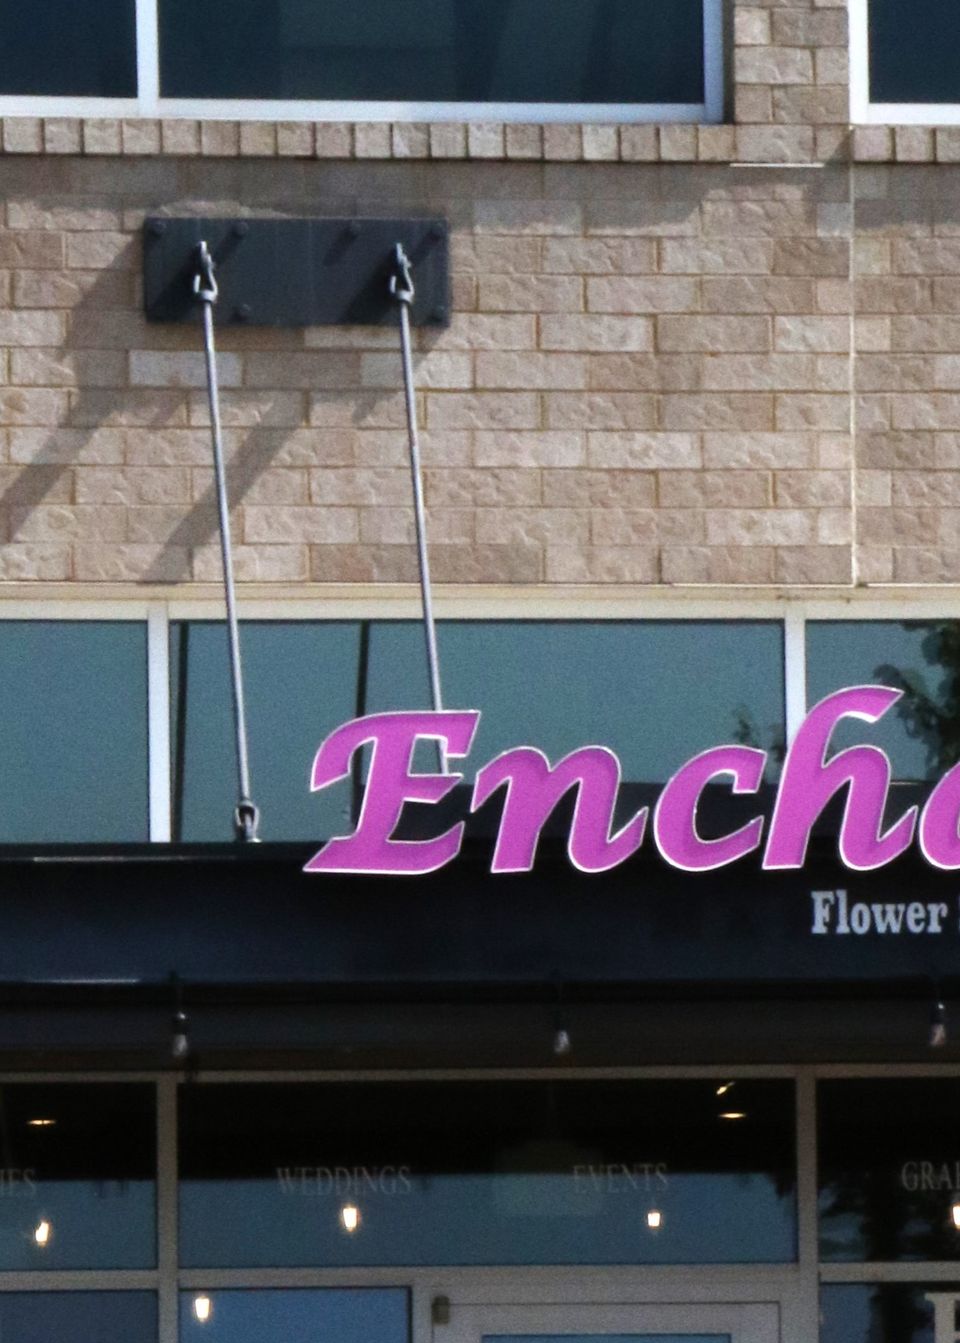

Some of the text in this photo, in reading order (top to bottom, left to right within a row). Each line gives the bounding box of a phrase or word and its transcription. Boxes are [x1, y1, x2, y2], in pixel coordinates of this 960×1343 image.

[811, 889, 948, 934] Flower
[277, 1165, 413, 1196] WEDDINGS
[573, 1163, 670, 1194] EVENTS
